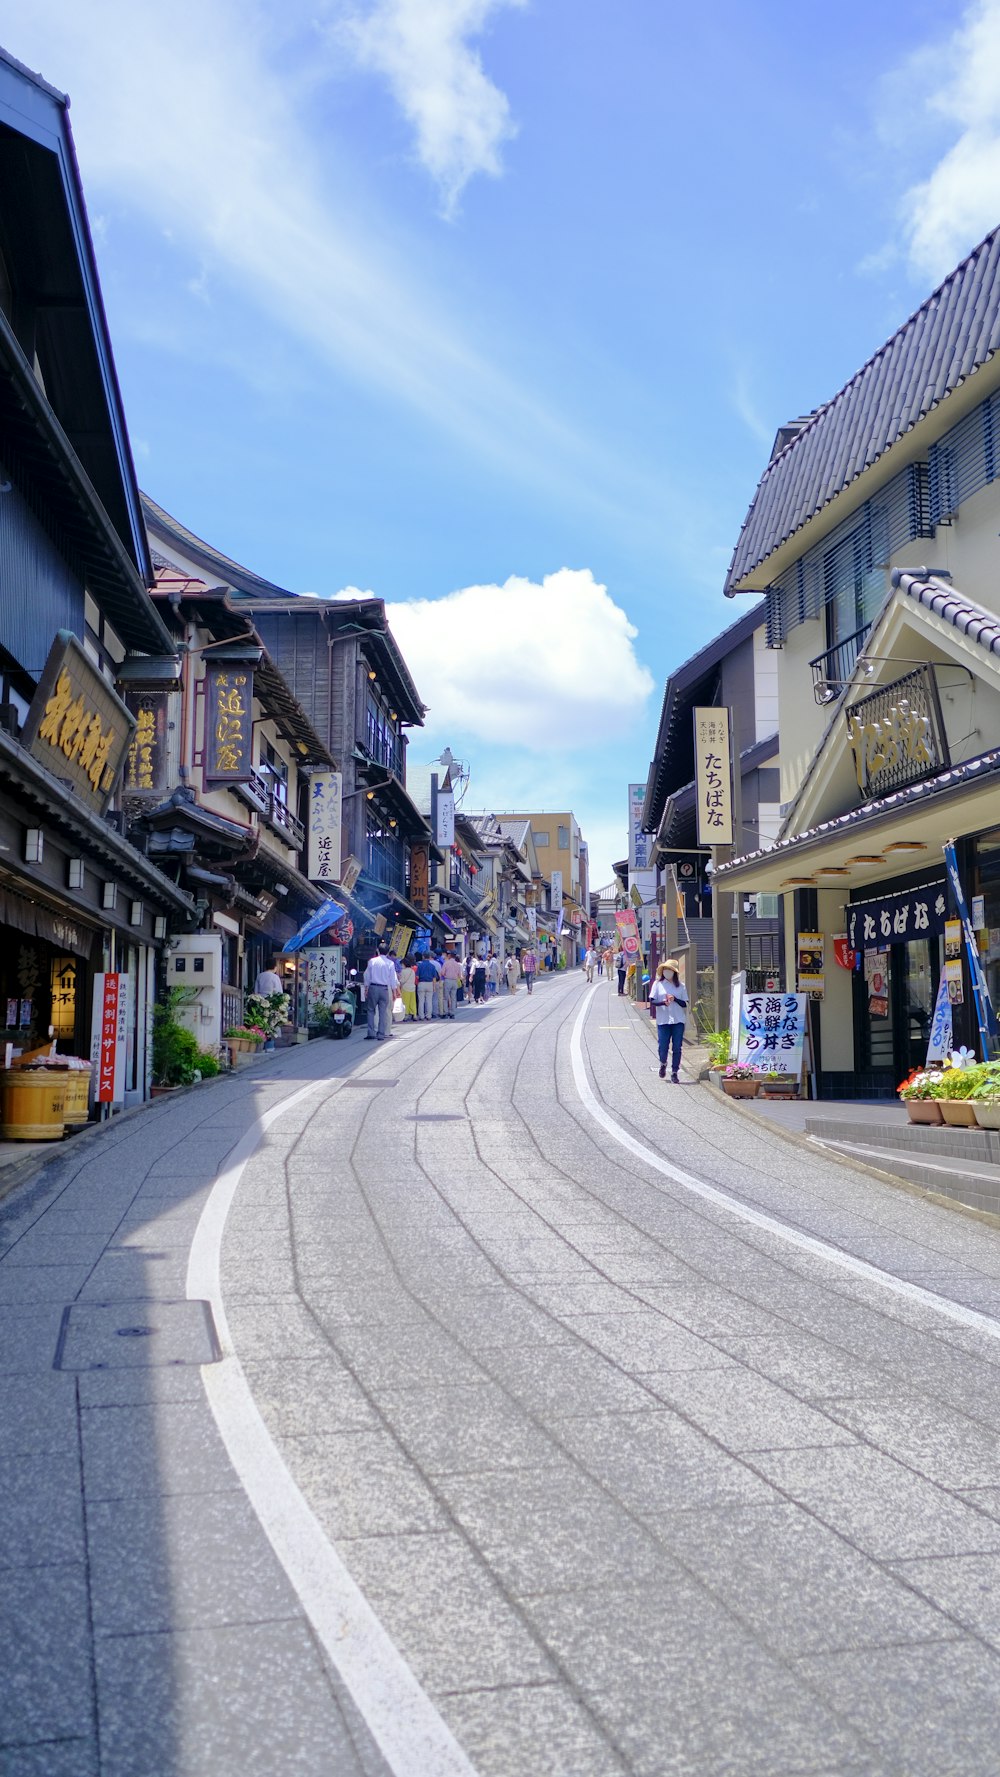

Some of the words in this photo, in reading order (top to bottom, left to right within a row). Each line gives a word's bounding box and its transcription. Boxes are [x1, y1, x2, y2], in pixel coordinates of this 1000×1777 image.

[216, 689, 246, 771] 近江屋
[700, 721, 708, 744] 天ぷら
[708, 721, 717, 744] 海鮮丼
[718, 721, 726, 744] うなぎ
[312, 782, 325, 834] 天ぷら
[327, 774, 339, 829] うなぎ
[705, 753, 724, 827] たちばな
[317, 836, 333, 877] 近江屋
[863, 902, 930, 940] たちばな
[101, 979, 117, 1090] 送料割引サービス
[745, 996, 764, 1050] 天ぷら
[763, 996, 781, 1050] 海鮮丼
[781, 997, 799, 1050] うなぎ
